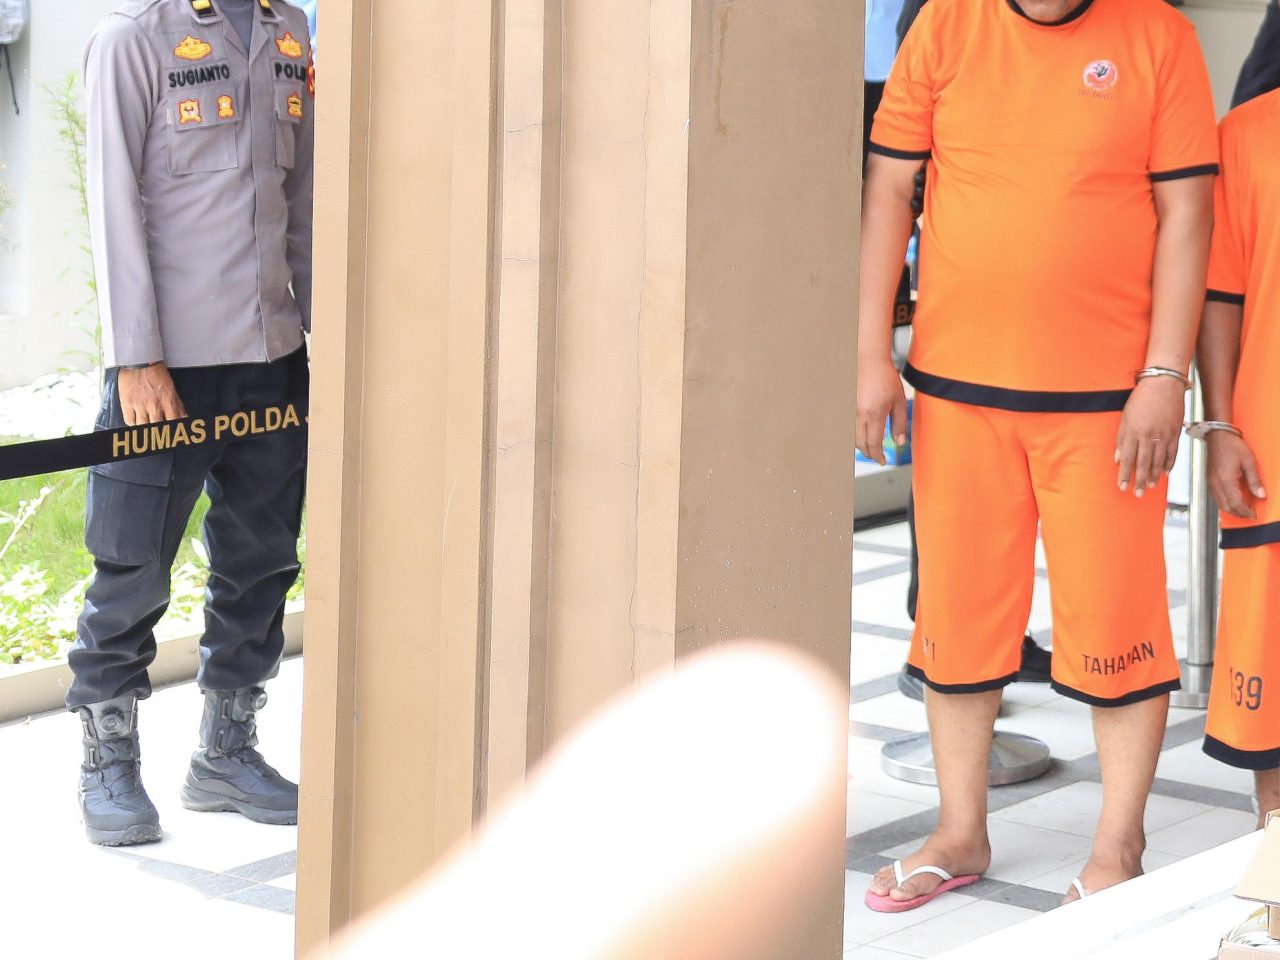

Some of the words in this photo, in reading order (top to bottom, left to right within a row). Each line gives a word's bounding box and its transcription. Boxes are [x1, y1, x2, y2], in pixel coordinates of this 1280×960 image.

[168, 63, 230, 88] SUGIANTO
[112, 418, 206, 457] HUMAS
[214, 404, 300, 440] POLDA
